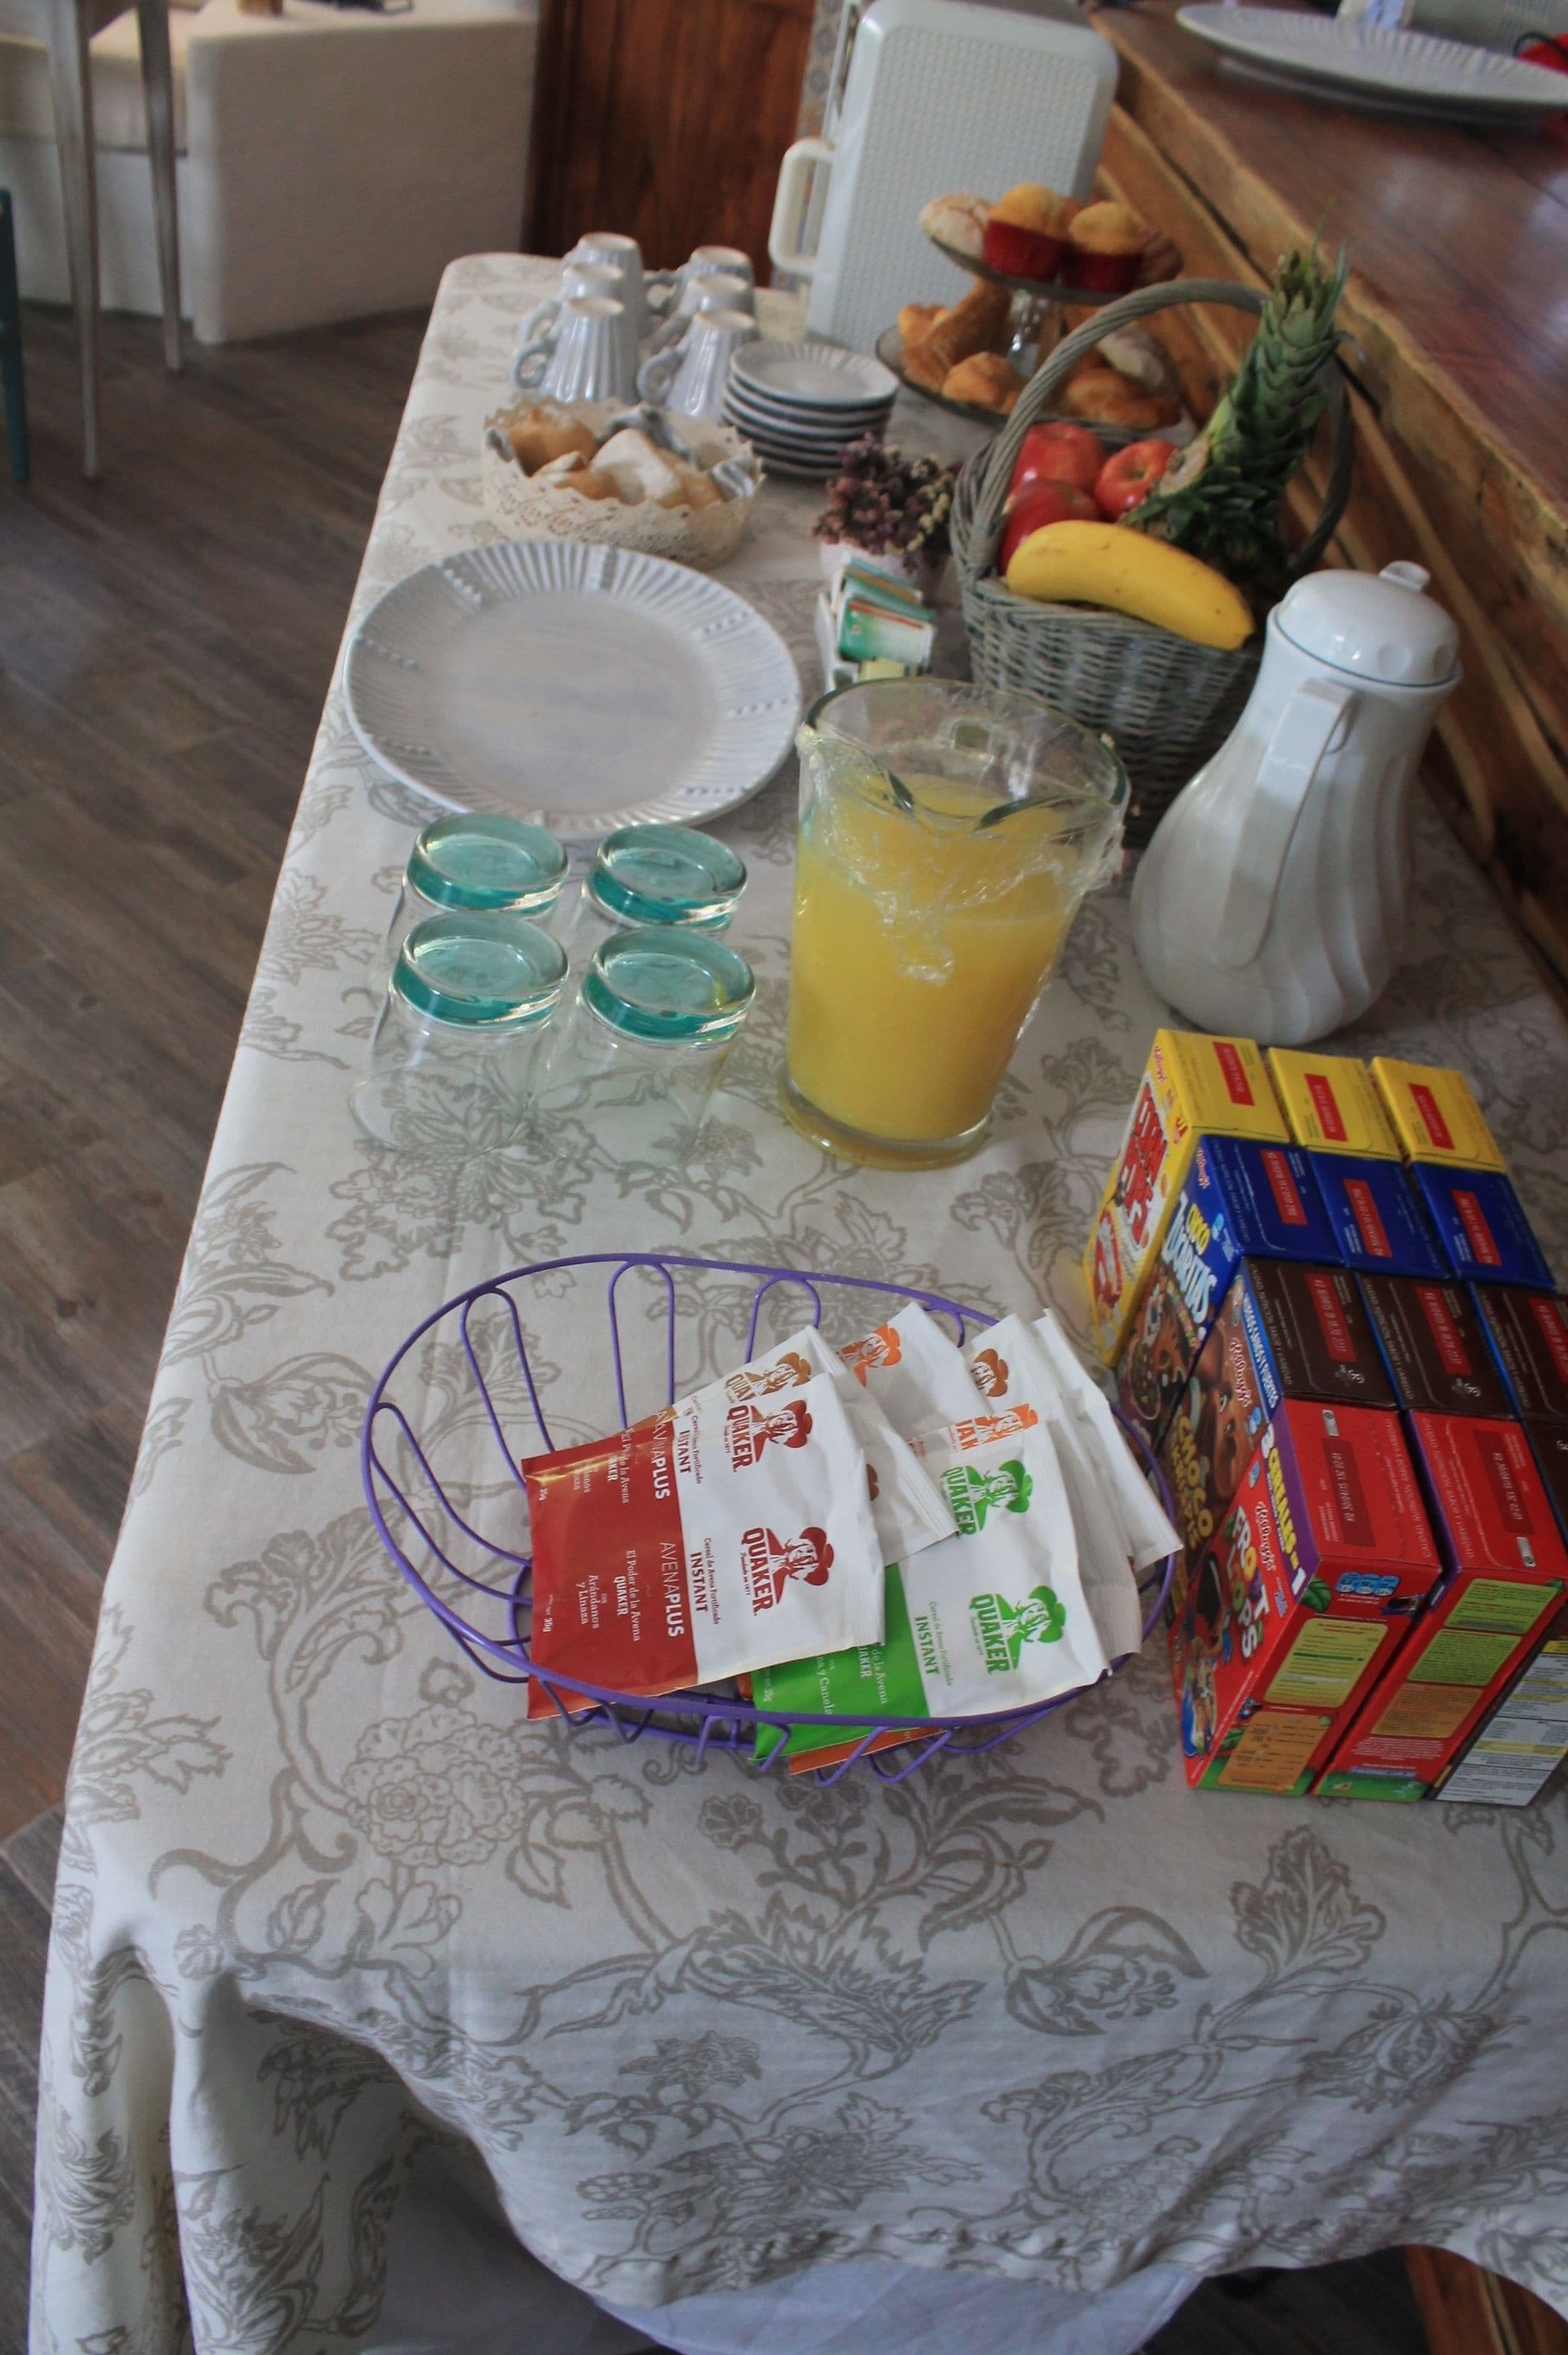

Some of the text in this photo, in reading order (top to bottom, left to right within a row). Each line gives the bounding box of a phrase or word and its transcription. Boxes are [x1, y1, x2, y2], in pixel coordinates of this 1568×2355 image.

[726, 1373, 756, 1401] QUA
[651, 1422, 670, 1499] AVAPLUS
[727, 1406, 753, 1473] QUAKER
[607, 1457, 618, 1482] AKER
[619, 1476, 631, 1503] Avena
[1255, 1501, 1276, 1571] Kellogg's
[612, 1576, 628, 1617] QUAKER
[626, 1550, 641, 1641] El Poder de la Avena
[660, 1542, 685, 1637] AVENAPLUS
[691, 1552, 708, 1612] INSTANT
[706, 1569, 715, 1588] Avena
[741, 1527, 773, 1616] QUAKER
[579, 1590, 589, 1624] Linaza
[588, 1575, 599, 1629] Arándanos
[709, 1588, 722, 1625] Fortificado
[915, 1616, 939, 1675] INSTANT
[969, 1593, 1010, 1675] QUAKER
[874, 1671, 890, 1704] Avena
